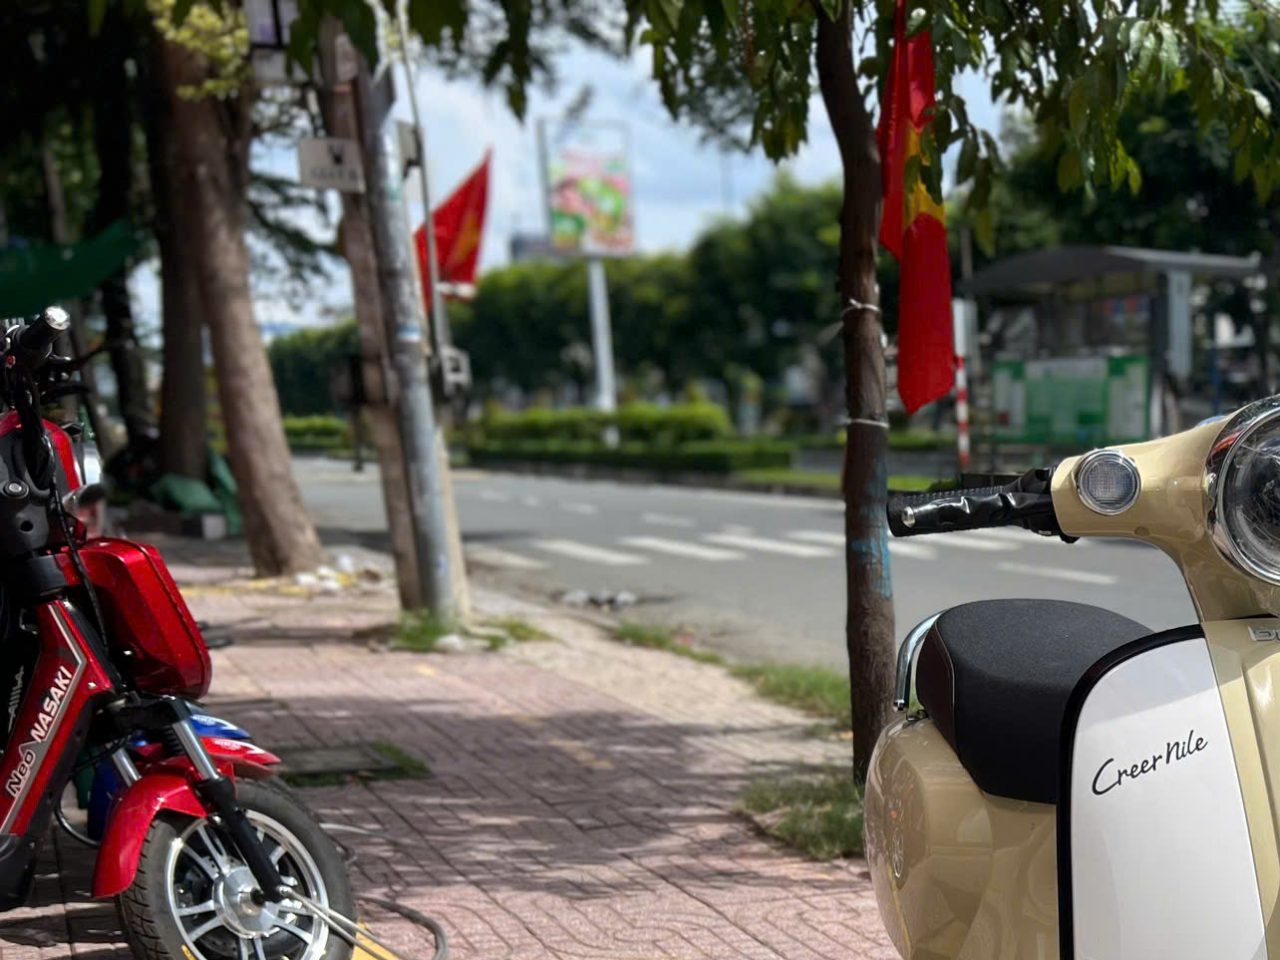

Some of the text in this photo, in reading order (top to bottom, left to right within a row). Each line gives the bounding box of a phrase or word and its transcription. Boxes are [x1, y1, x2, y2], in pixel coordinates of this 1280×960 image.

[5, 749, 36, 797] Neo
[30, 665, 73, 743] NASAKI
[1091, 757, 1163, 796] Creer
